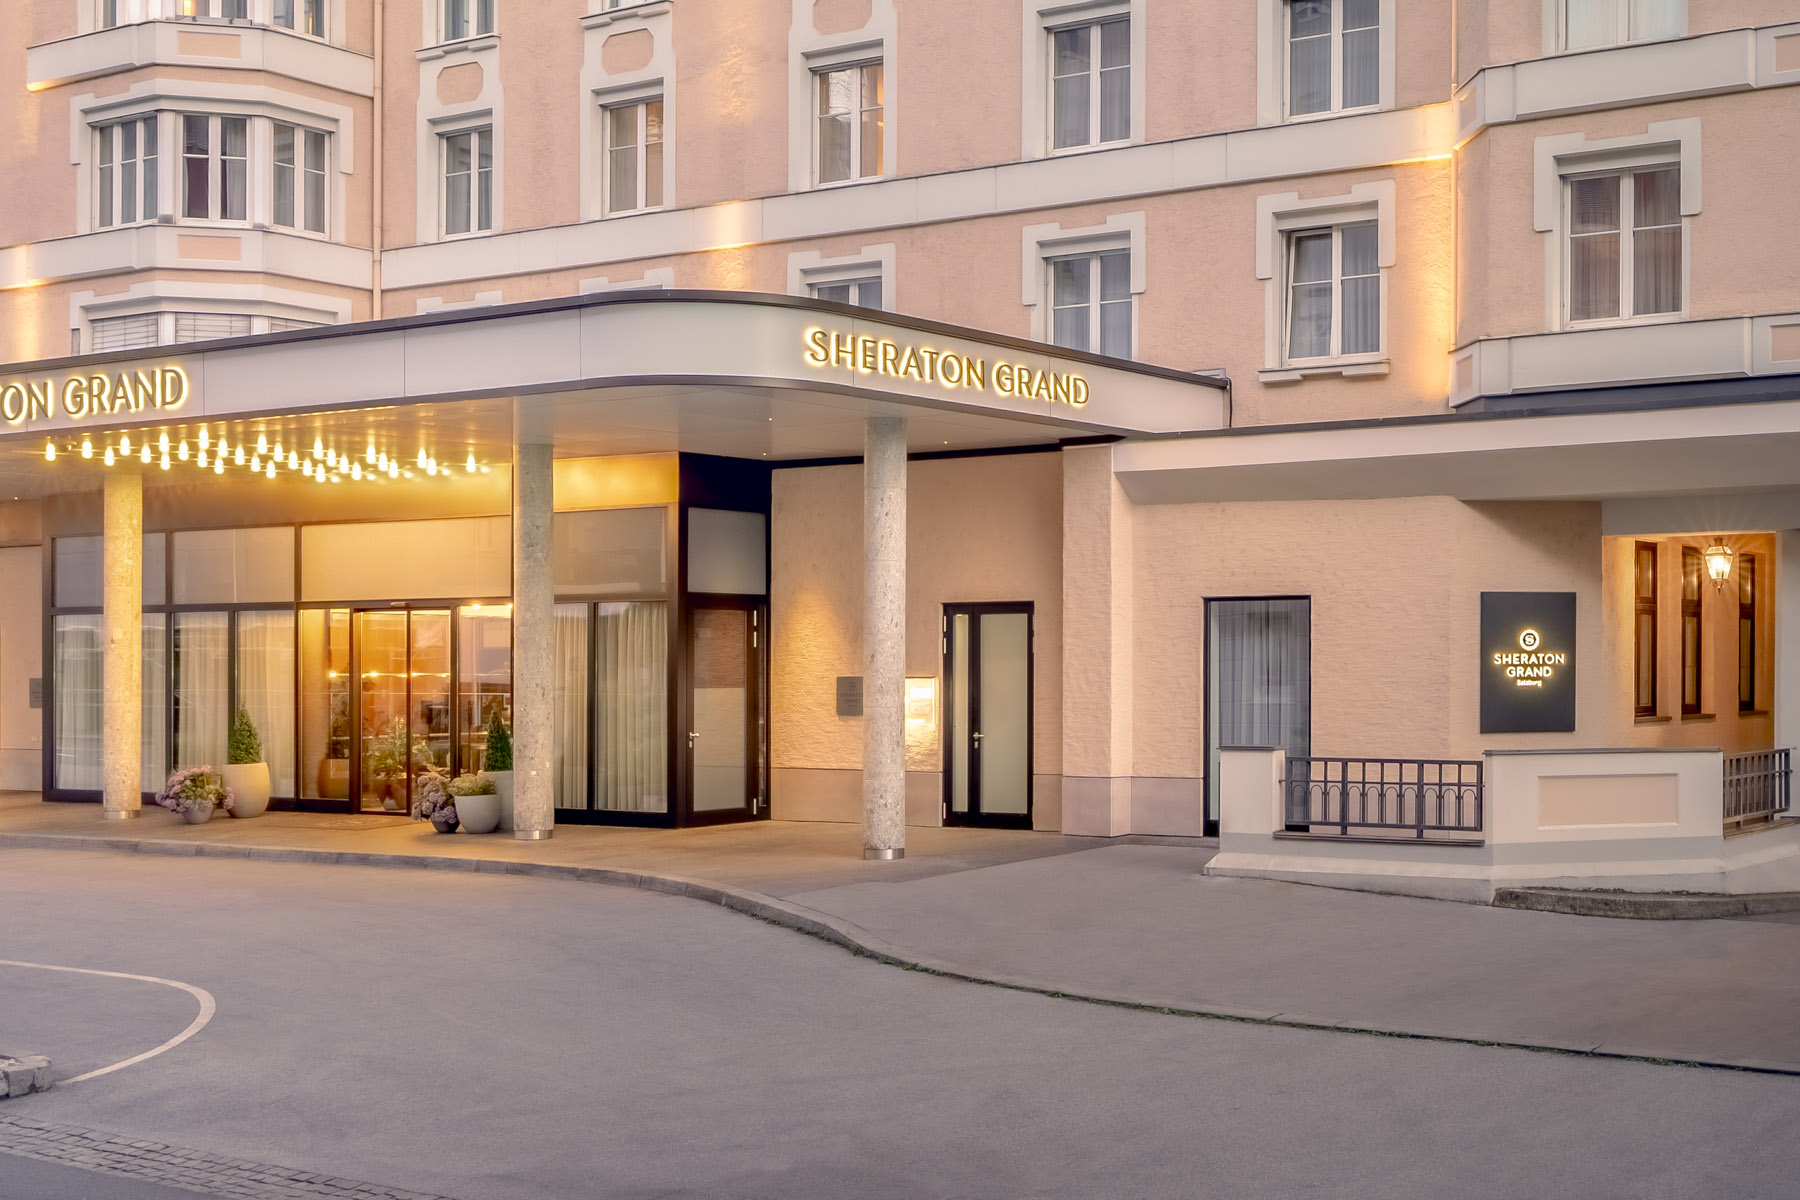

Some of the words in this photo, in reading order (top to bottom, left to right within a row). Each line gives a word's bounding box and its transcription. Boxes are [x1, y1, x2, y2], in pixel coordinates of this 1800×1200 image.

[806, 329, 986, 389] SHERATON
[993, 362, 1090, 405] GRAND
[62, 367, 187, 417] GRAND
[1493, 653, 1565, 665] SHERATON
[1506, 666, 1552, 678] GRAND
[1516, 679, 1542, 687] Salzburg
